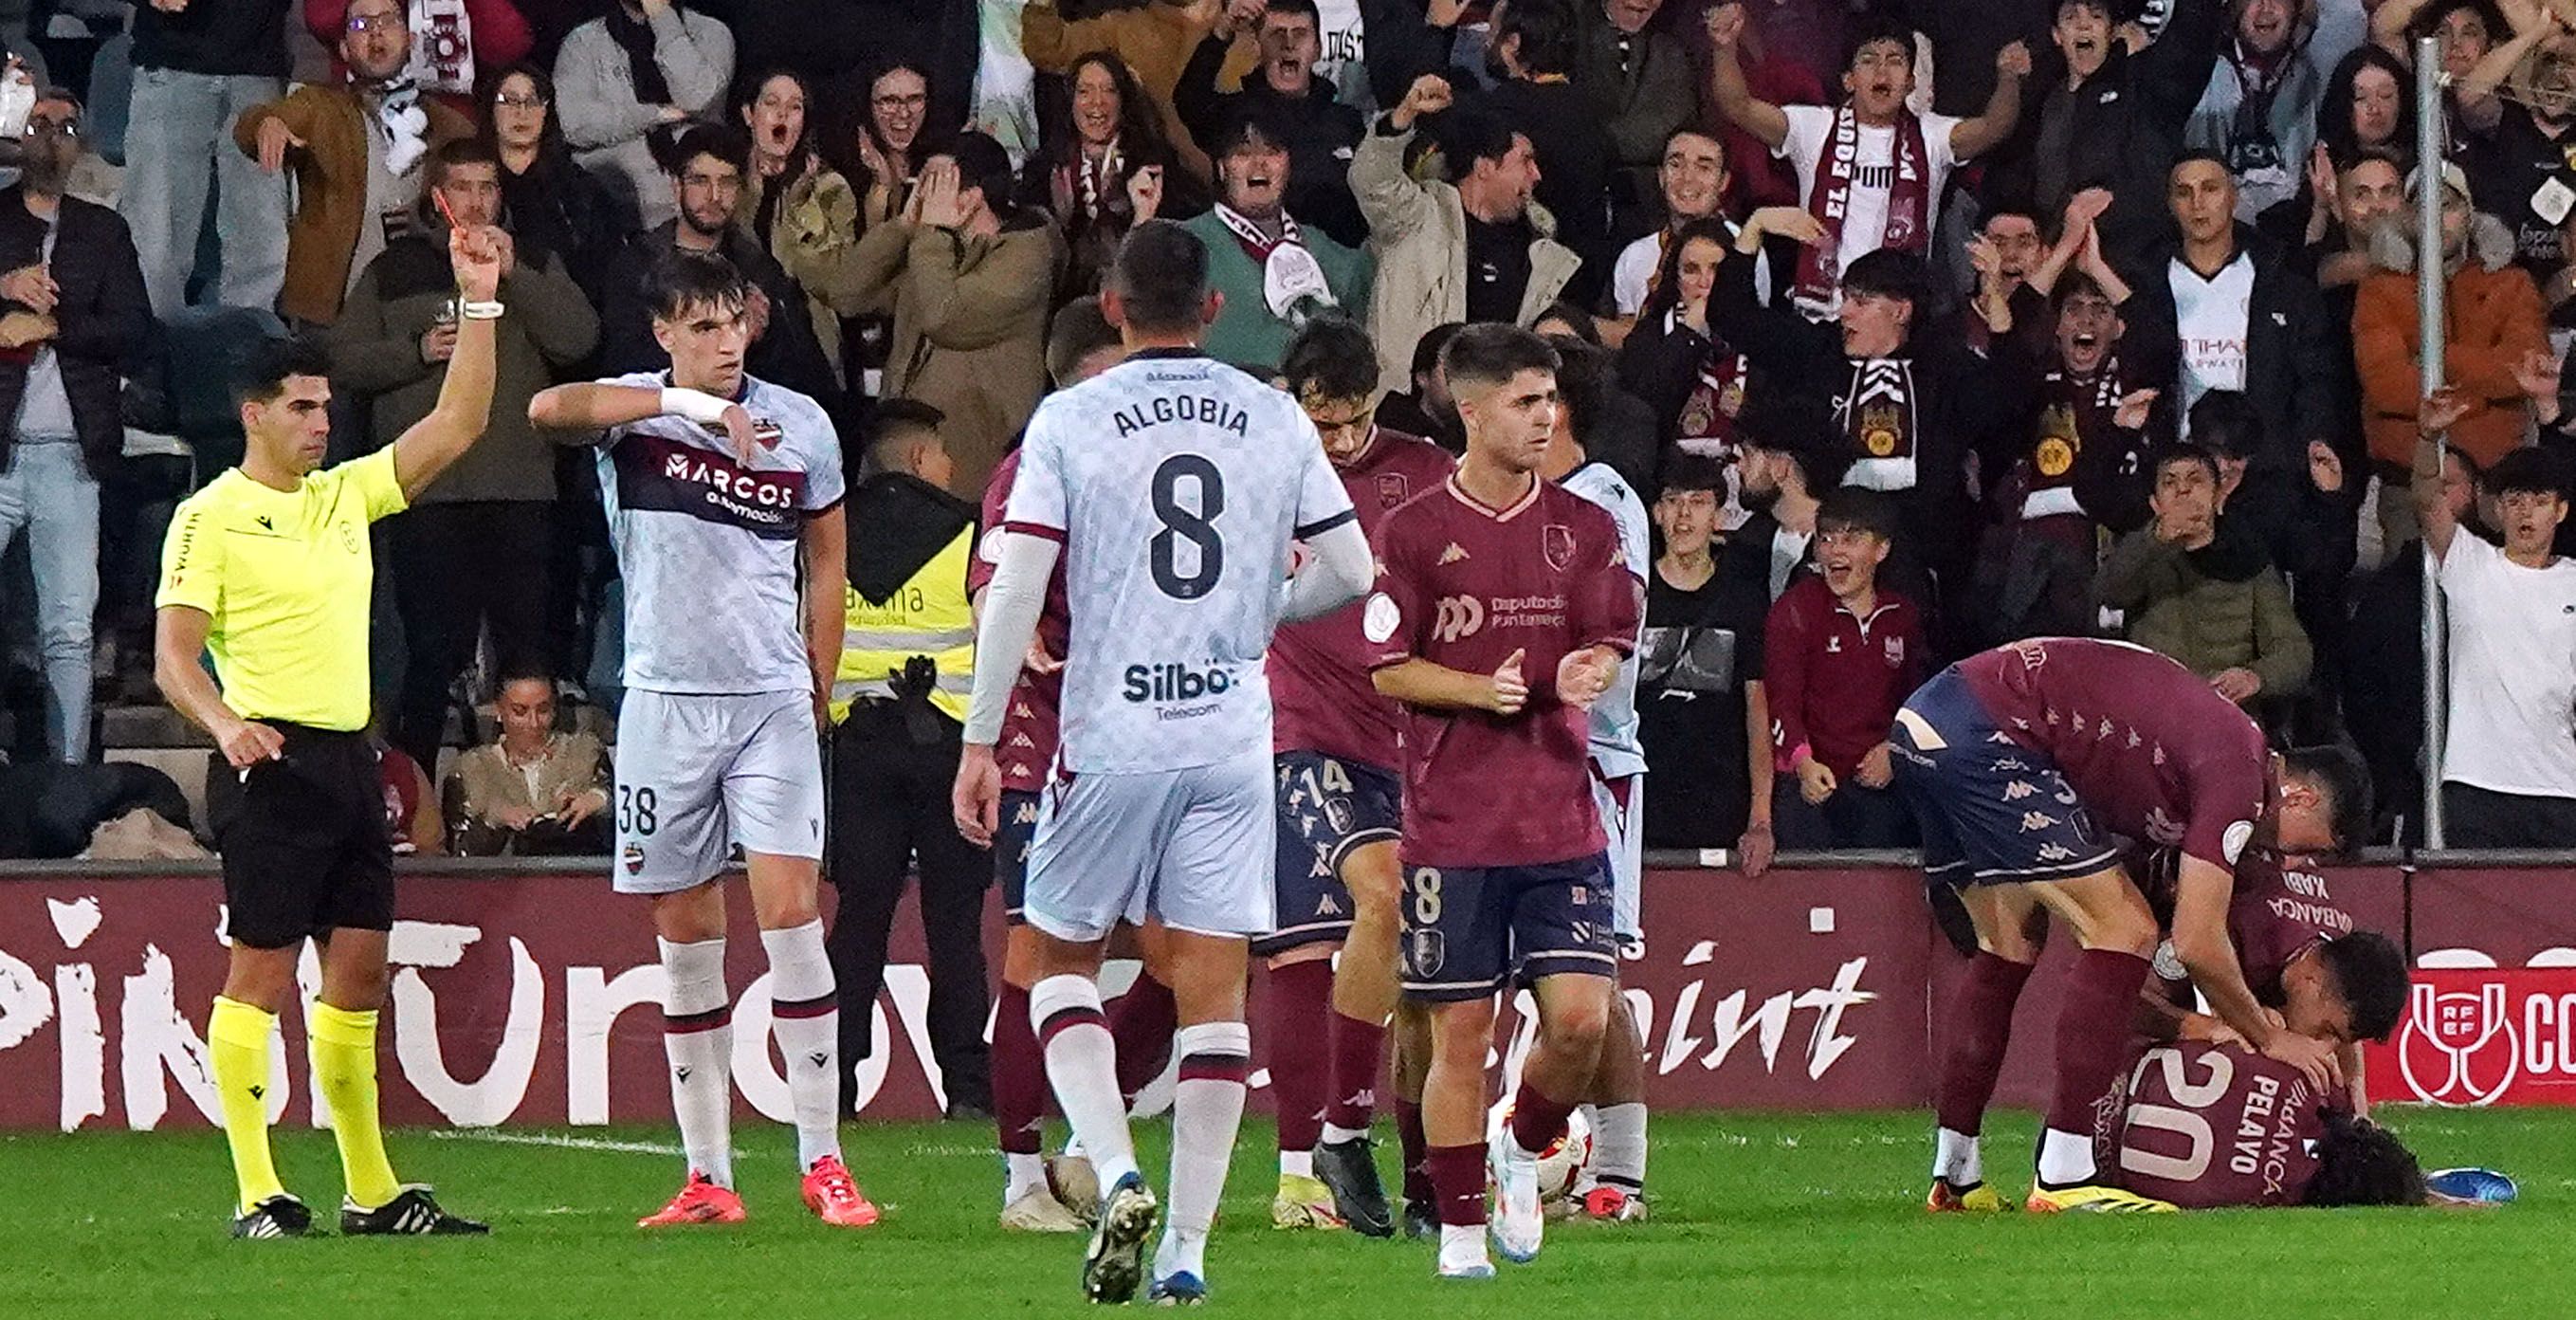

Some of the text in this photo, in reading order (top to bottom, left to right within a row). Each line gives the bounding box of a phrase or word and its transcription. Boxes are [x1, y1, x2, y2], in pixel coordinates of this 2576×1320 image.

[1113, 394, 1250, 438] ALGOBIA
[666, 453, 793, 508] MARCOS
[1150, 452, 1226, 601] 8
[1154, 704, 1223, 731] Telecom
[618, 784, 657, 836] 38
[1300, 759, 1354, 809] 14
[1414, 867, 1442, 925] 8
[2442, 1006, 2476, 1019] RF
[2442, 1022, 2476, 1036] EF
[2120, 1047, 2234, 1182] 20
[2230, 1074, 2280, 1175] PELAYO
